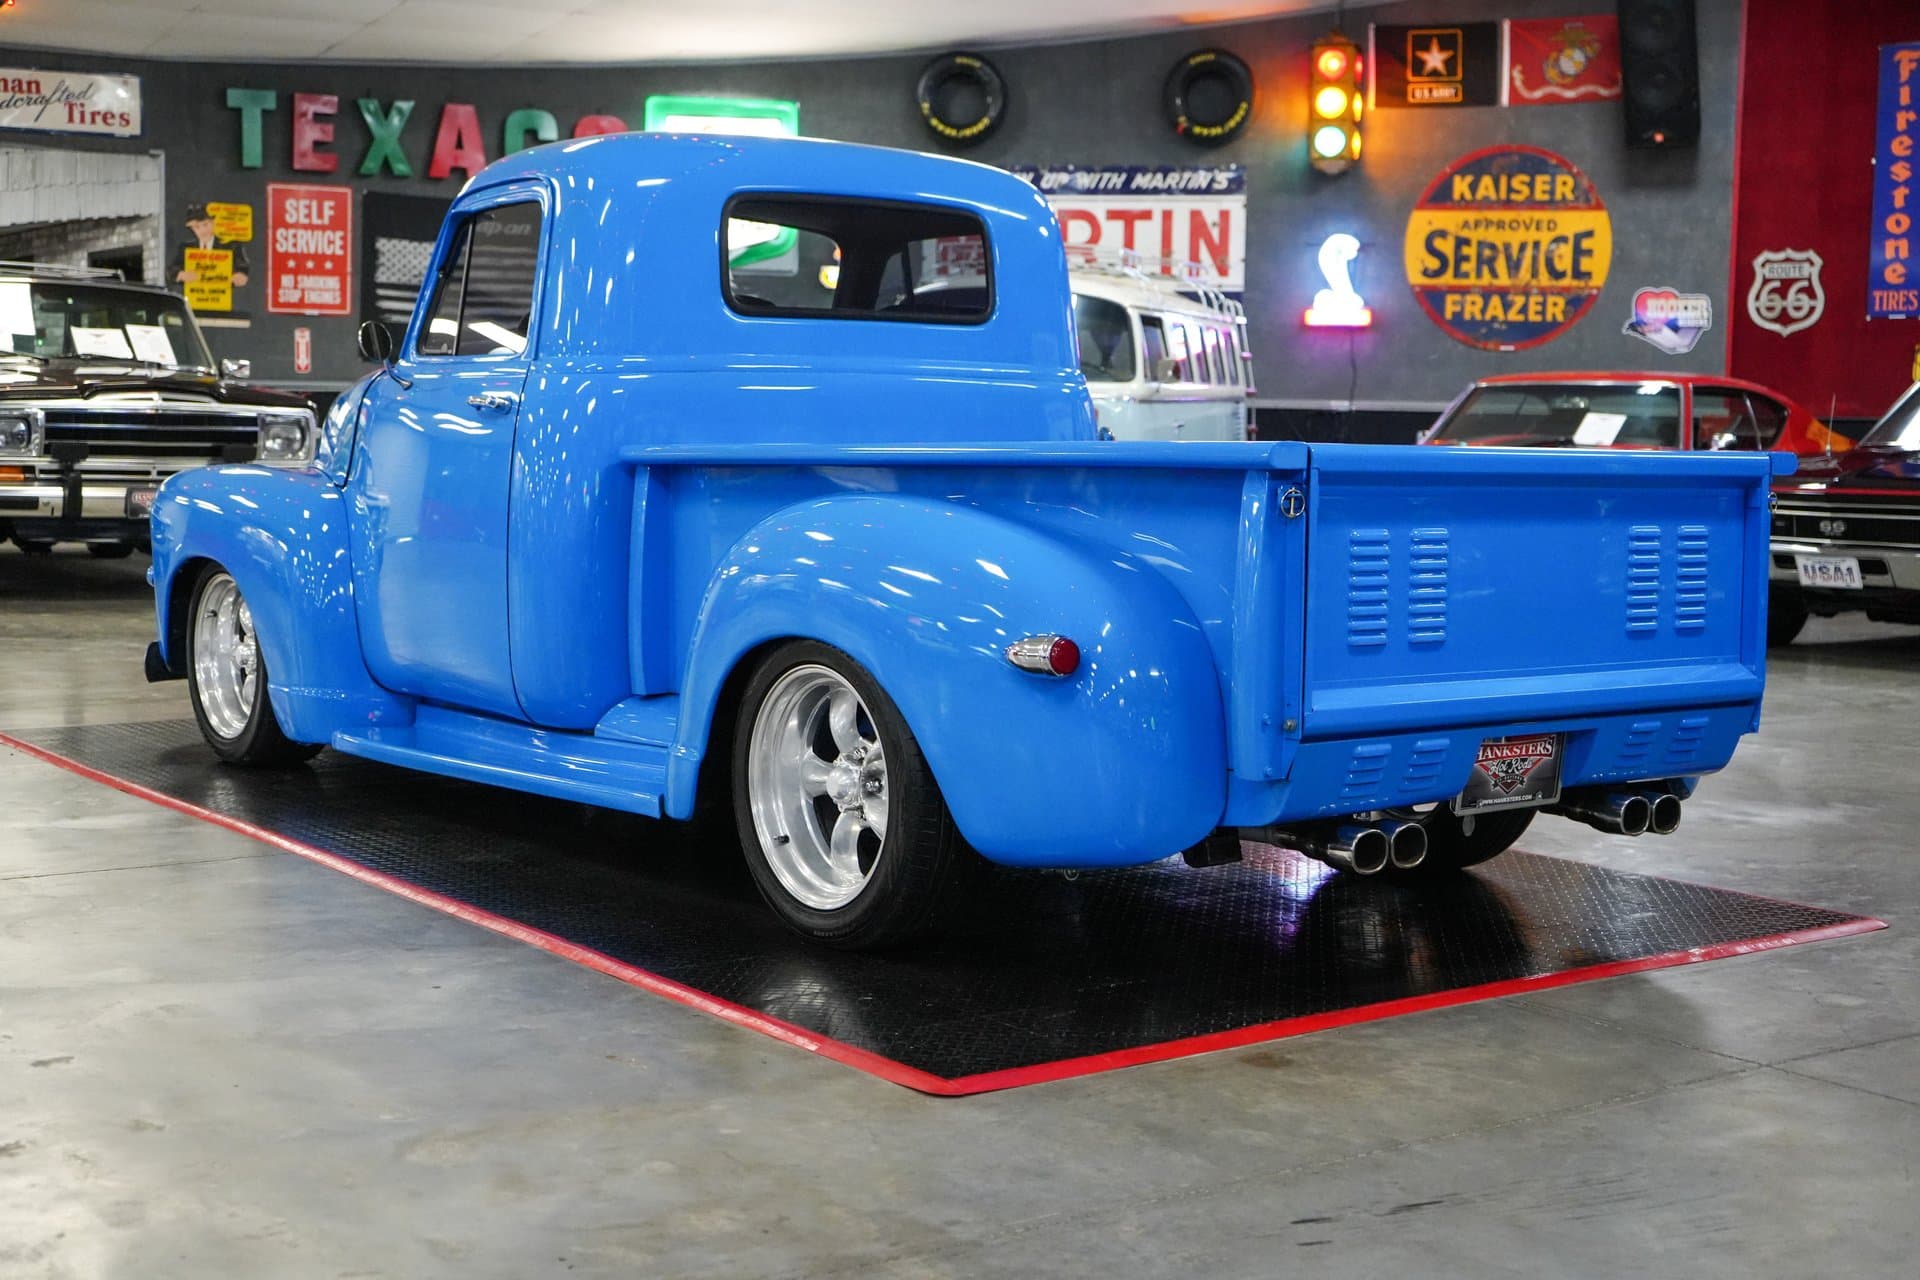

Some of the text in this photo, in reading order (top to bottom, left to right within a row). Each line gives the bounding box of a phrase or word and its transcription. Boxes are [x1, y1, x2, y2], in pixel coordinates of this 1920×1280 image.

[63, 101, 131, 128] Tires
[226, 88, 628, 180] TEXAC
[1040, 172, 1070, 190] UP
[1075, 171, 1124, 190] WITH
[1130, 170, 1229, 190] MARTIN'S
[1884, 50, 1920, 285] Firestone
[1453, 173, 1576, 202] KAISER
[285, 198, 336, 226] SELF
[1461, 218, 1558, 232] APPROVED
[275, 227, 345, 256] SERVICE
[1422, 229, 1595, 281] SERVICE
[1768, 265, 1805, 277] ROUTE
[1444, 293, 1567, 322] FRAZER
[1760, 280, 1810, 319] 66
[1873, 289, 1919, 312] TIRES
[1488, 759, 1508, 775] Hot
